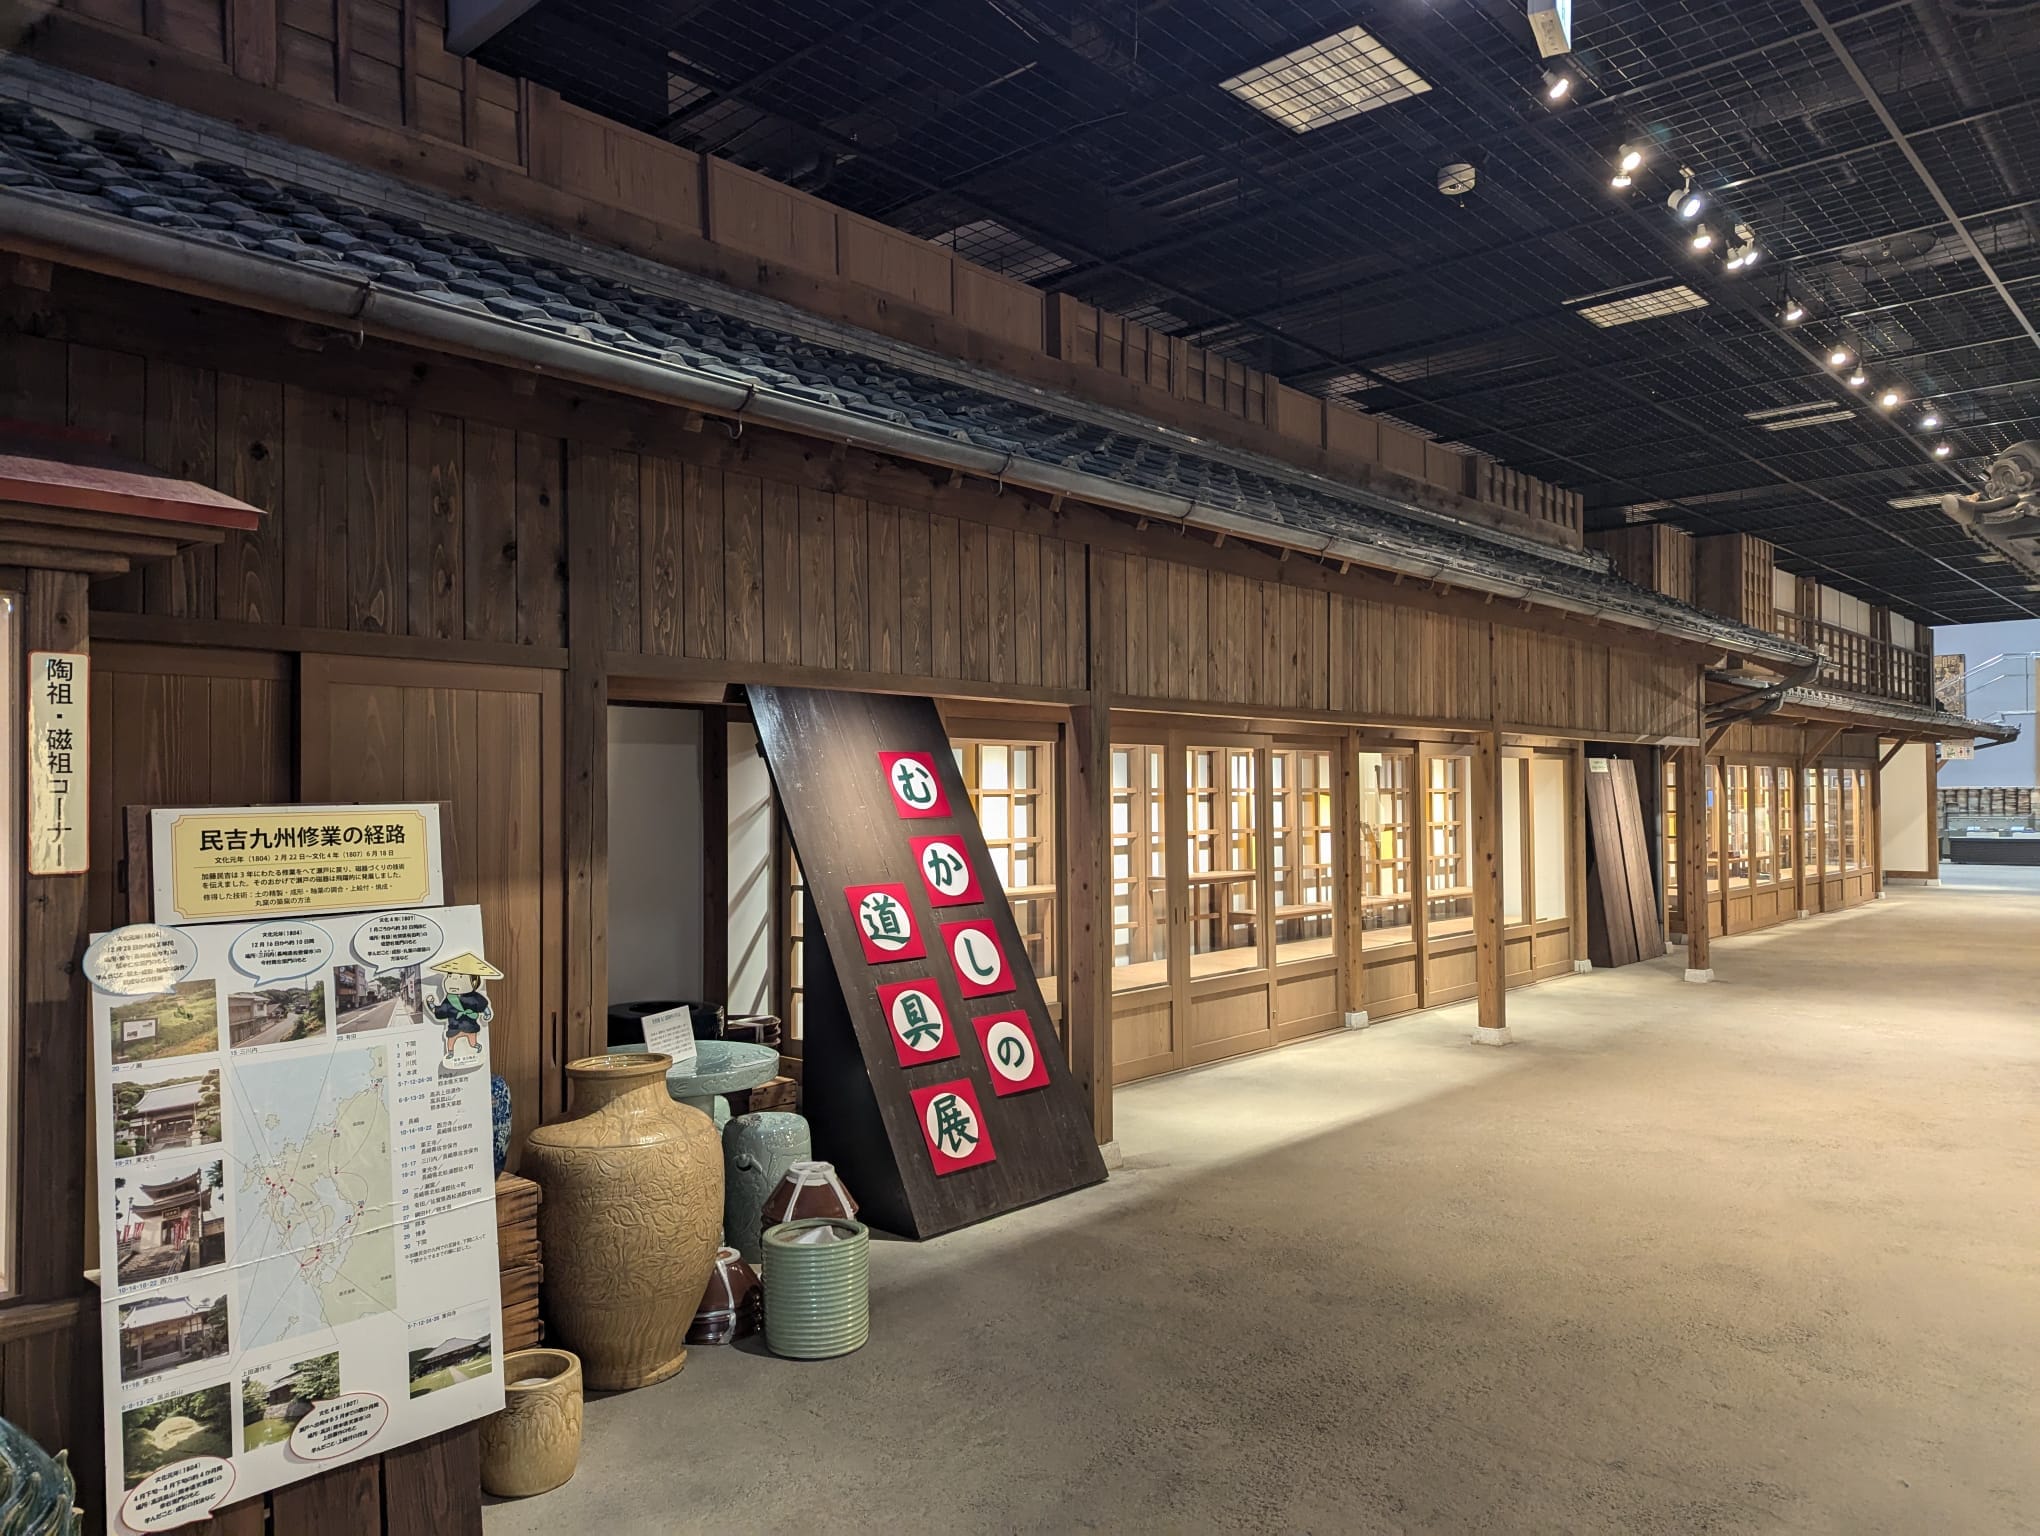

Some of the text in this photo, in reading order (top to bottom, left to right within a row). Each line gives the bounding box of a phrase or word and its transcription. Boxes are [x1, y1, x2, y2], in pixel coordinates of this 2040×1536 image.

[47, 659, 73, 866] 陶祖・磁祖コーナー
[200, 824, 405, 851] 民吉九州修業の経路
[861, 895, 979, 1154] 道具展
[898, 764, 1026, 1068] むかしの
